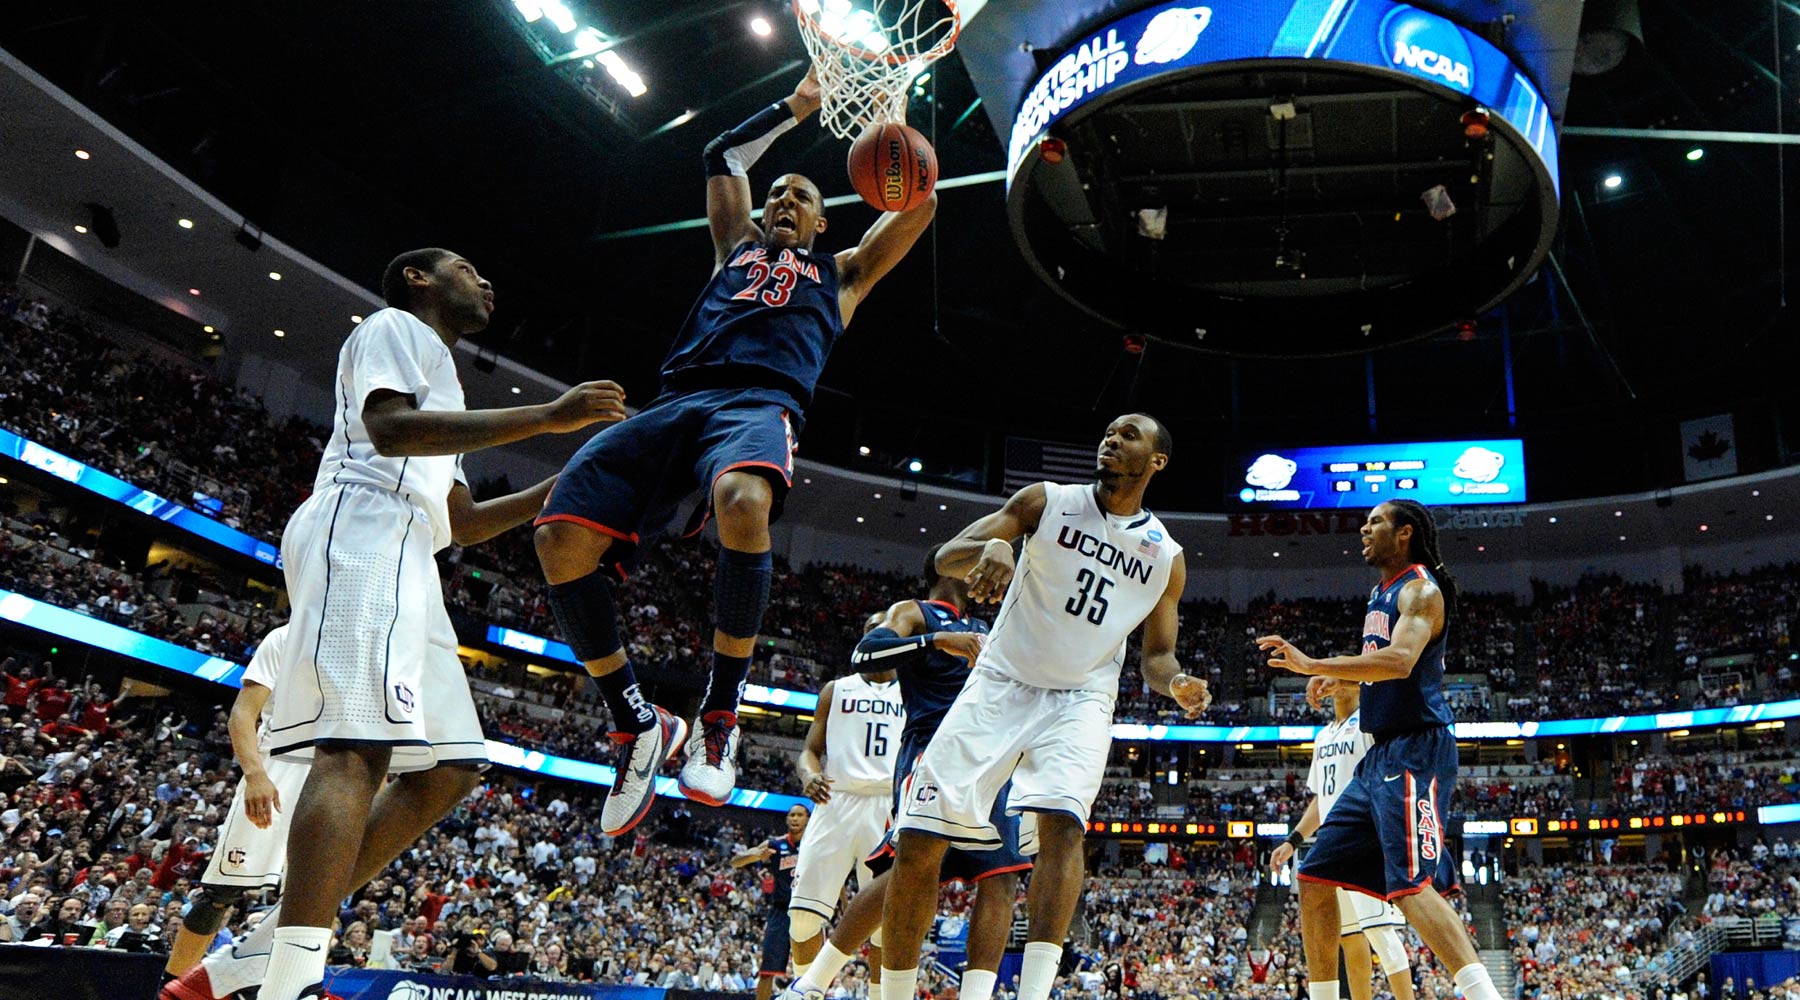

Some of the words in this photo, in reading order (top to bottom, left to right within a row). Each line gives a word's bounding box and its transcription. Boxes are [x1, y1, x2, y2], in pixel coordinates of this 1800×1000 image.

[1392, 40, 1470, 89] NCAA
[885, 140, 903, 201] Wilson
[728, 247, 822, 284] ARONA
[730, 261, 798, 307] 23
[1228, 510, 1366, 538] HOND
[1057, 525, 1153, 585] UCONN
[1065, 568, 1115, 626] 35
[865, 722, 889, 757] 15
[1323, 764, 1336, 797] 13
[1417, 799, 1436, 860] CATS
[432, 987, 475, 1000] NCAA
